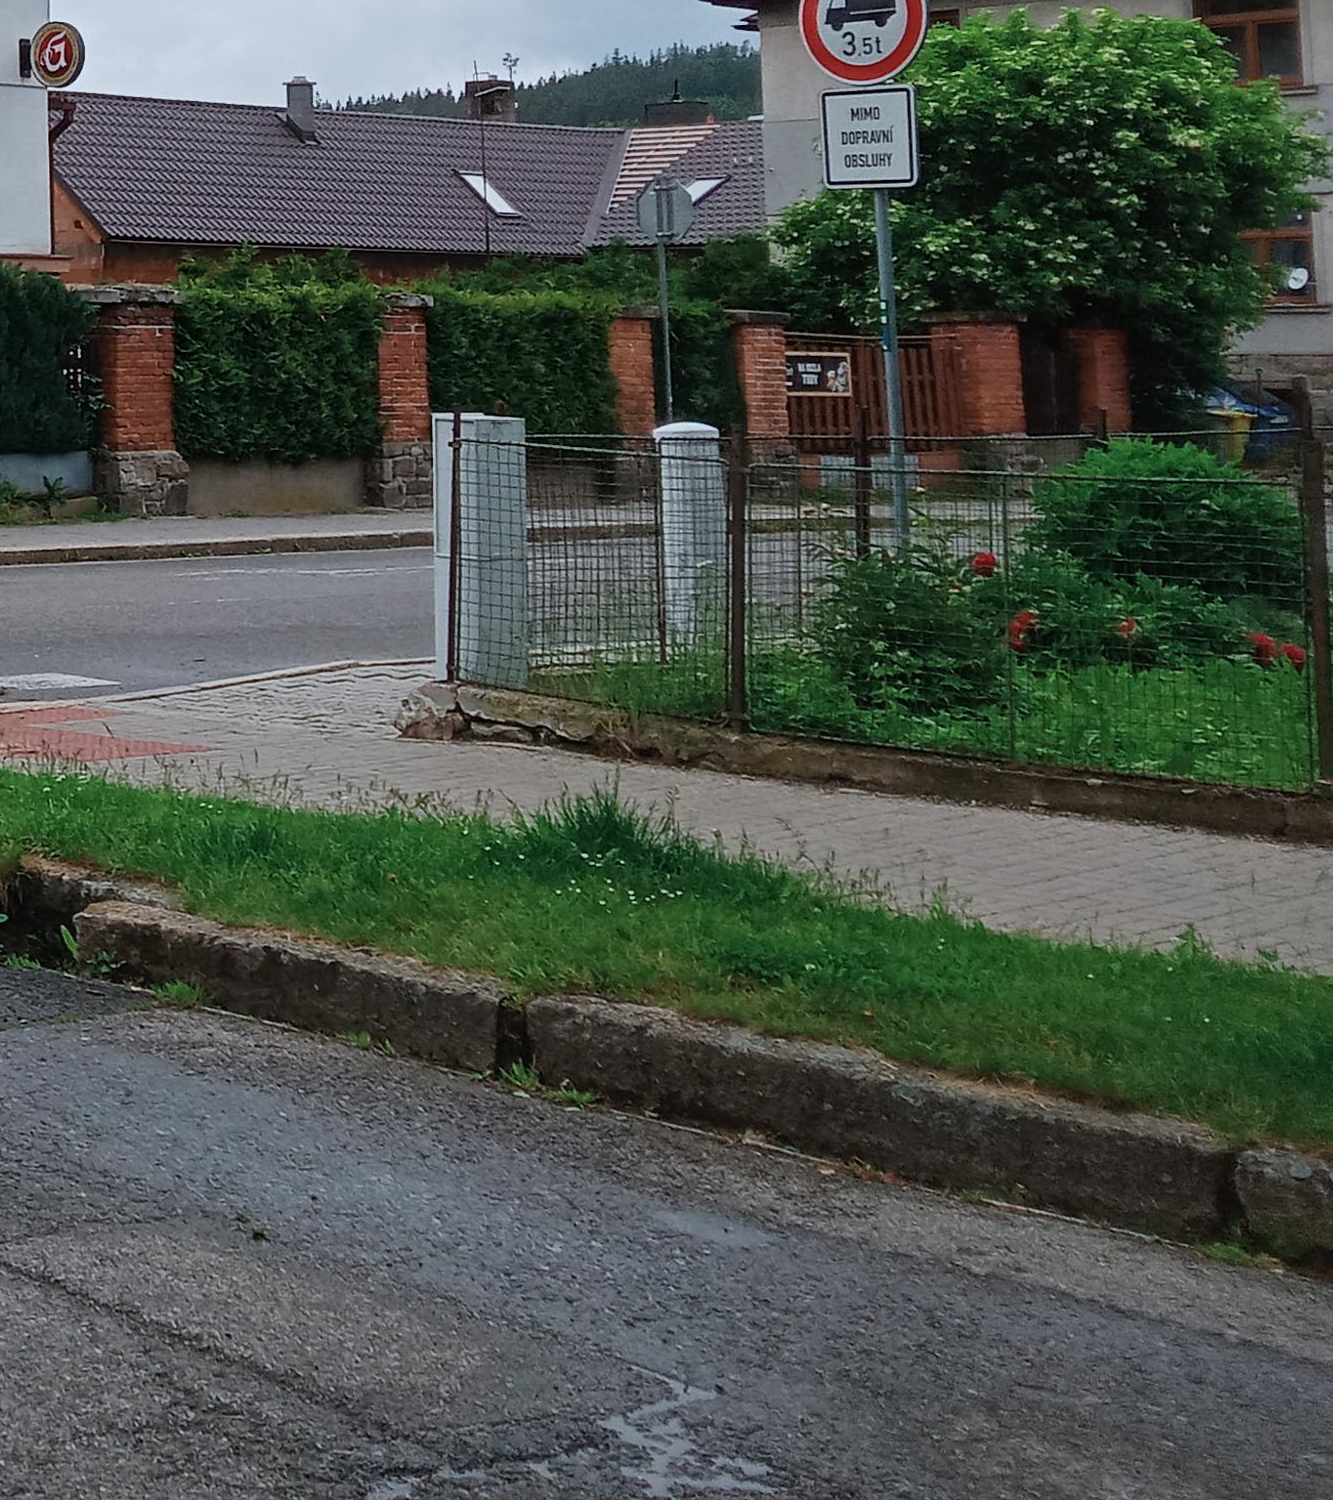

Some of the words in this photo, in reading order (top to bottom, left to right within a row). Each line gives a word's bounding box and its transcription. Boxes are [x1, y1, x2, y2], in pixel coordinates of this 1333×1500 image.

[850, 106, 880, 122] MIMO
[841, 125, 893, 146] DOPRAVNÍ
[844, 153, 893, 169] OBSLUHY
